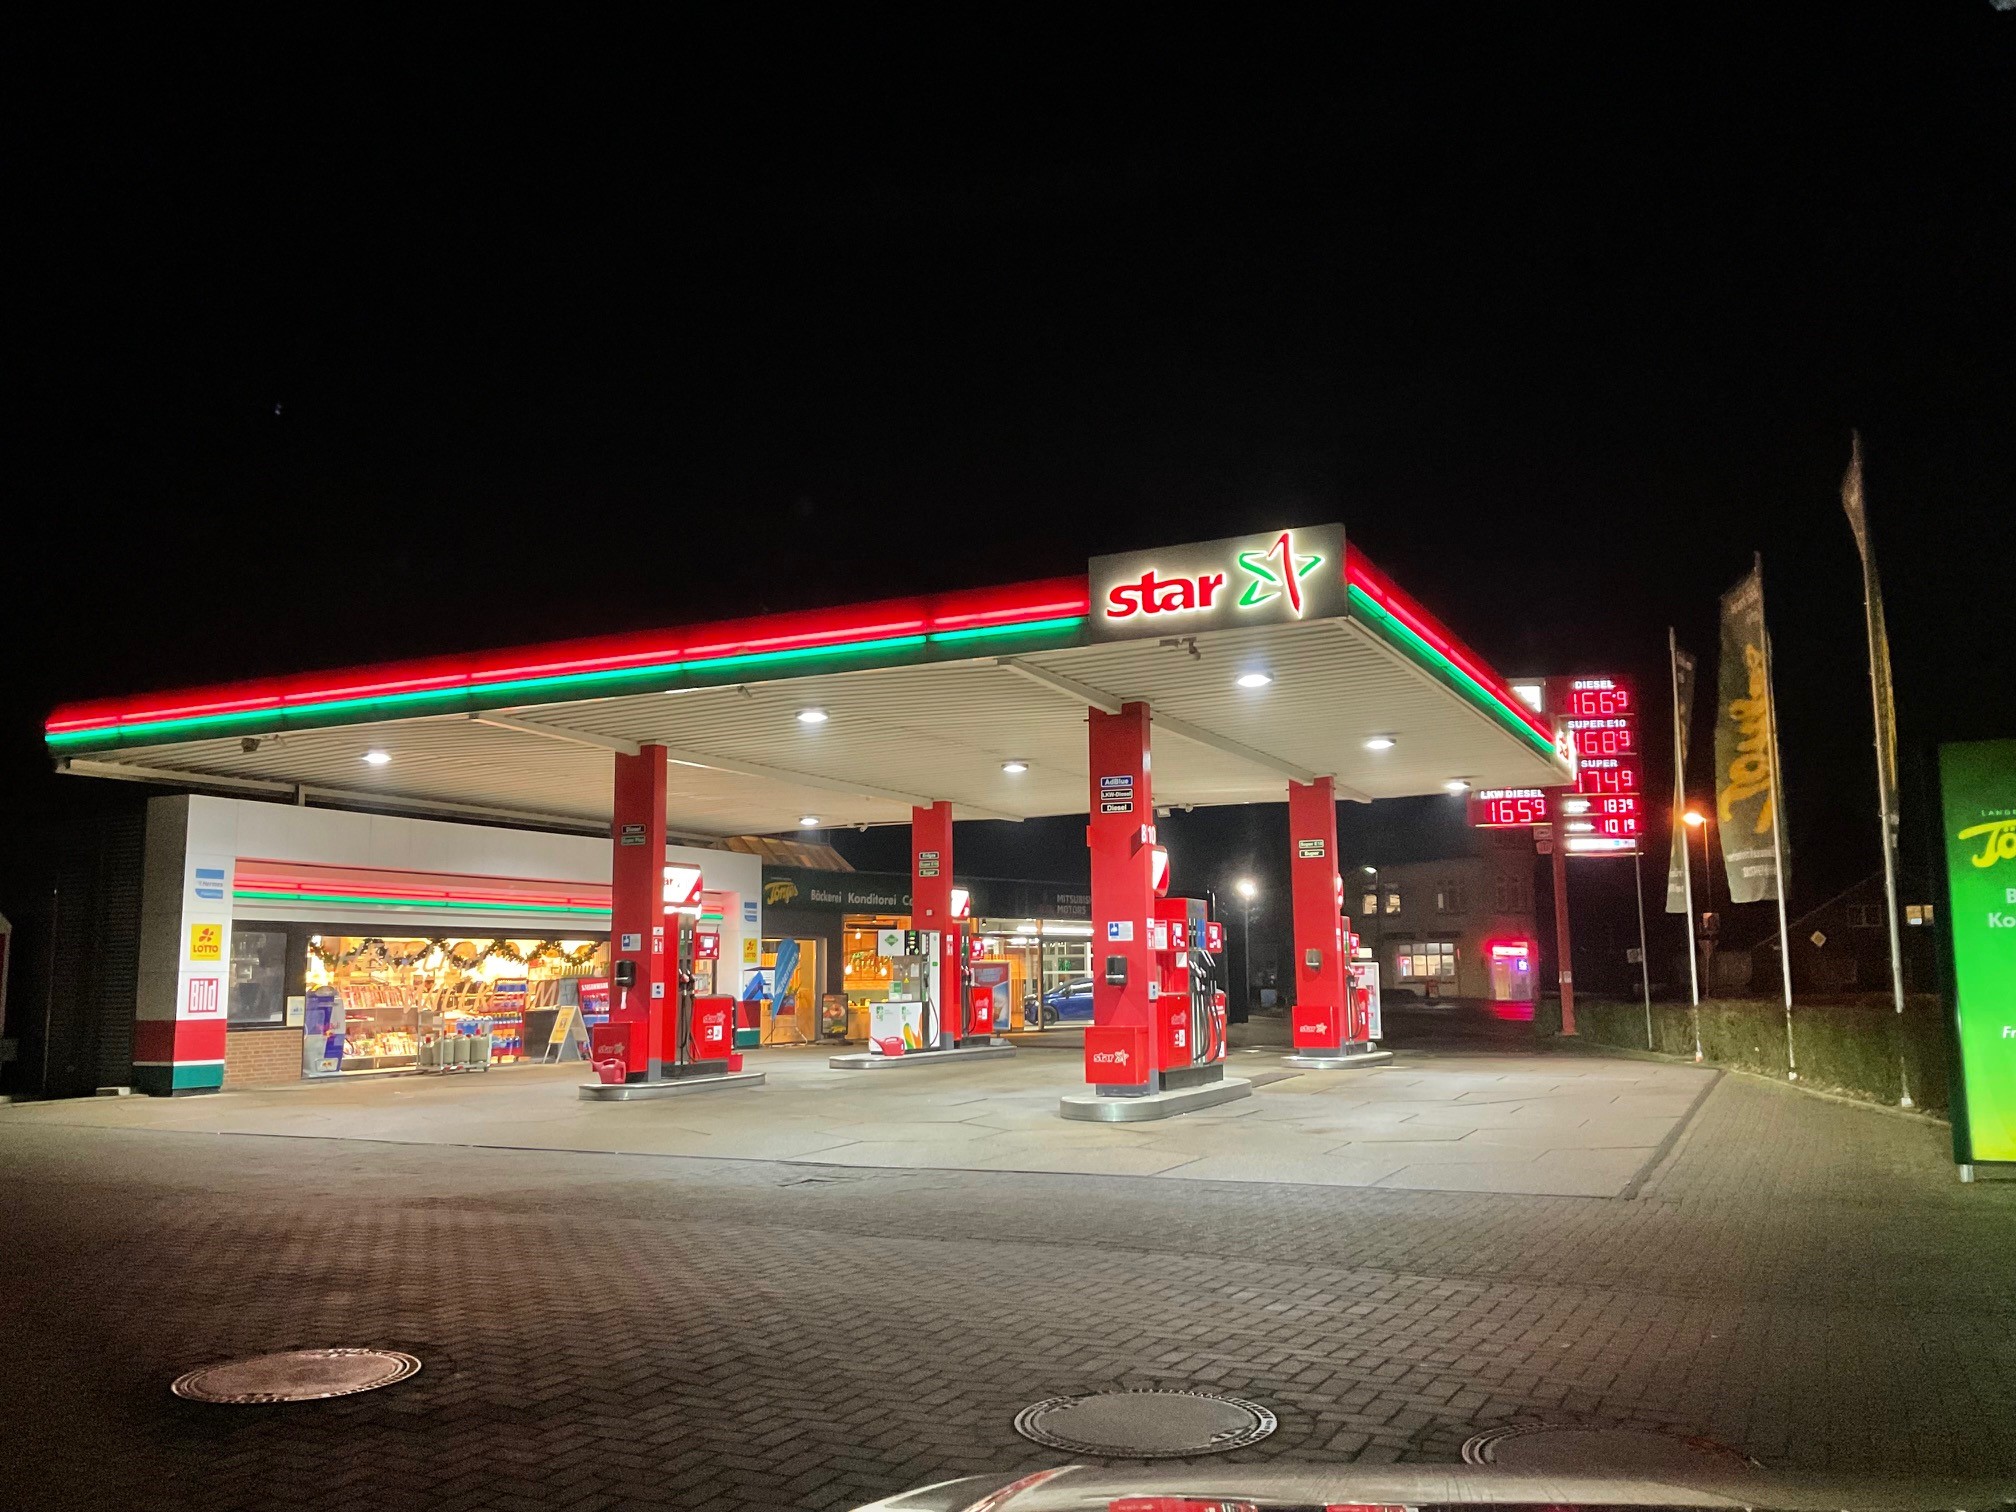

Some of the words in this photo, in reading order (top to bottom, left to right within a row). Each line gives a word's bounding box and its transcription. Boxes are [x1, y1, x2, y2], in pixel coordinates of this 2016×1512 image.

[1107, 570, 1224, 618] star
[1575, 680, 1615, 689] DIESEL
[1607, 719, 1626, 727] E10
[1581, 760, 1617, 768] SUPER
[1481, 791, 1503, 799] LKW
[1505, 789, 1544, 798] DIESEL
[811, 889, 841, 903] Bäckerei
[848, 892, 897, 906] Konditorei
[1057, 905, 1086, 914] MOTORS
[193, 945, 218, 953] LOTTO
[190, 980, 216, 1011] Bild
[1094, 1052, 1114, 1062] star
